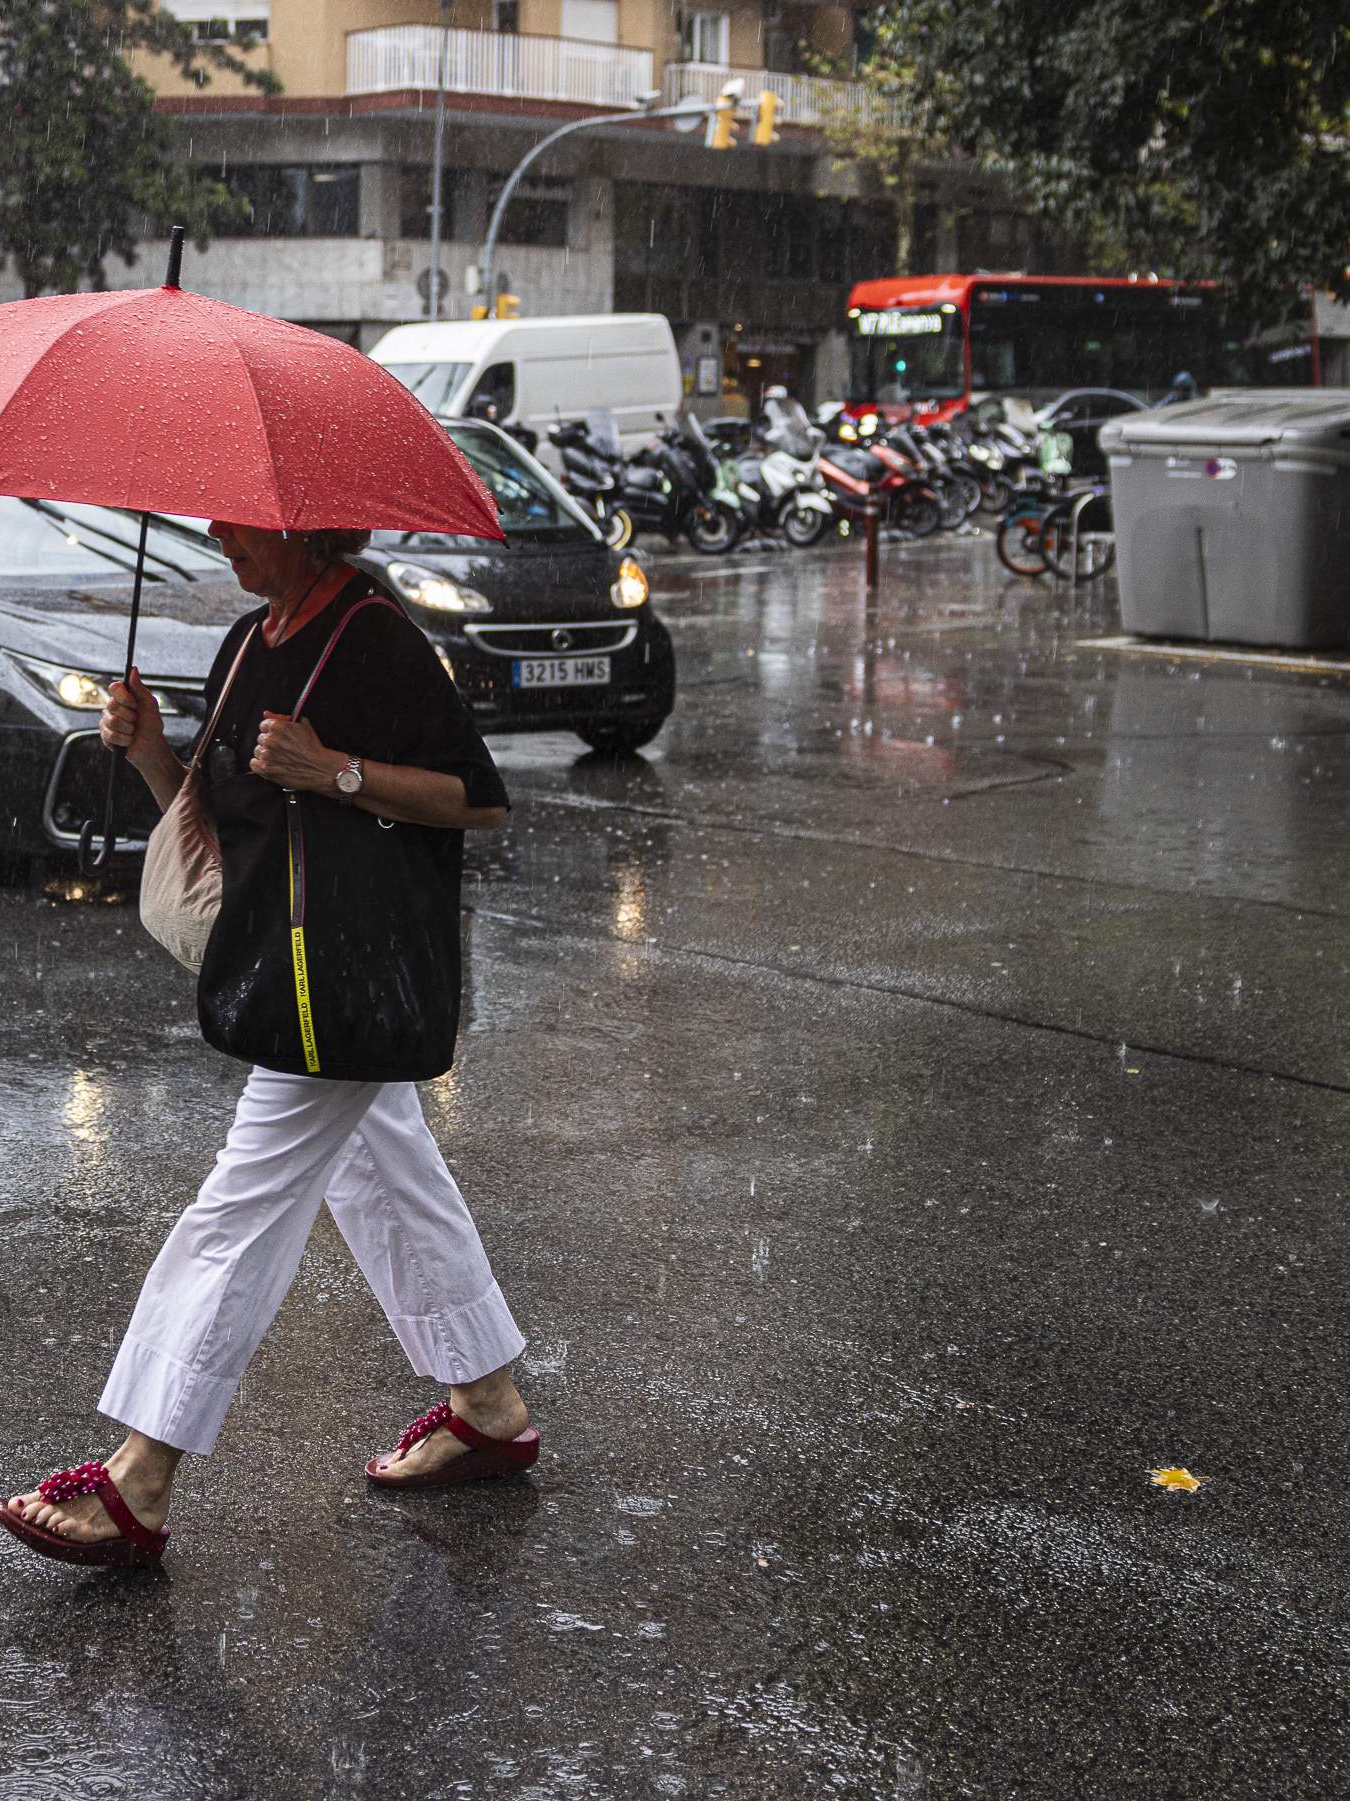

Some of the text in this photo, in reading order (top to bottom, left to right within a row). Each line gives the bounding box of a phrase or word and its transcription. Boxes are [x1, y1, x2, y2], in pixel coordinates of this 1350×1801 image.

[524, 660, 606, 683] 3215 HMS
[294, 931, 307, 997] KARL LAGERFELD
[301, 1002, 317, 1067] KARL LAGERFELD
